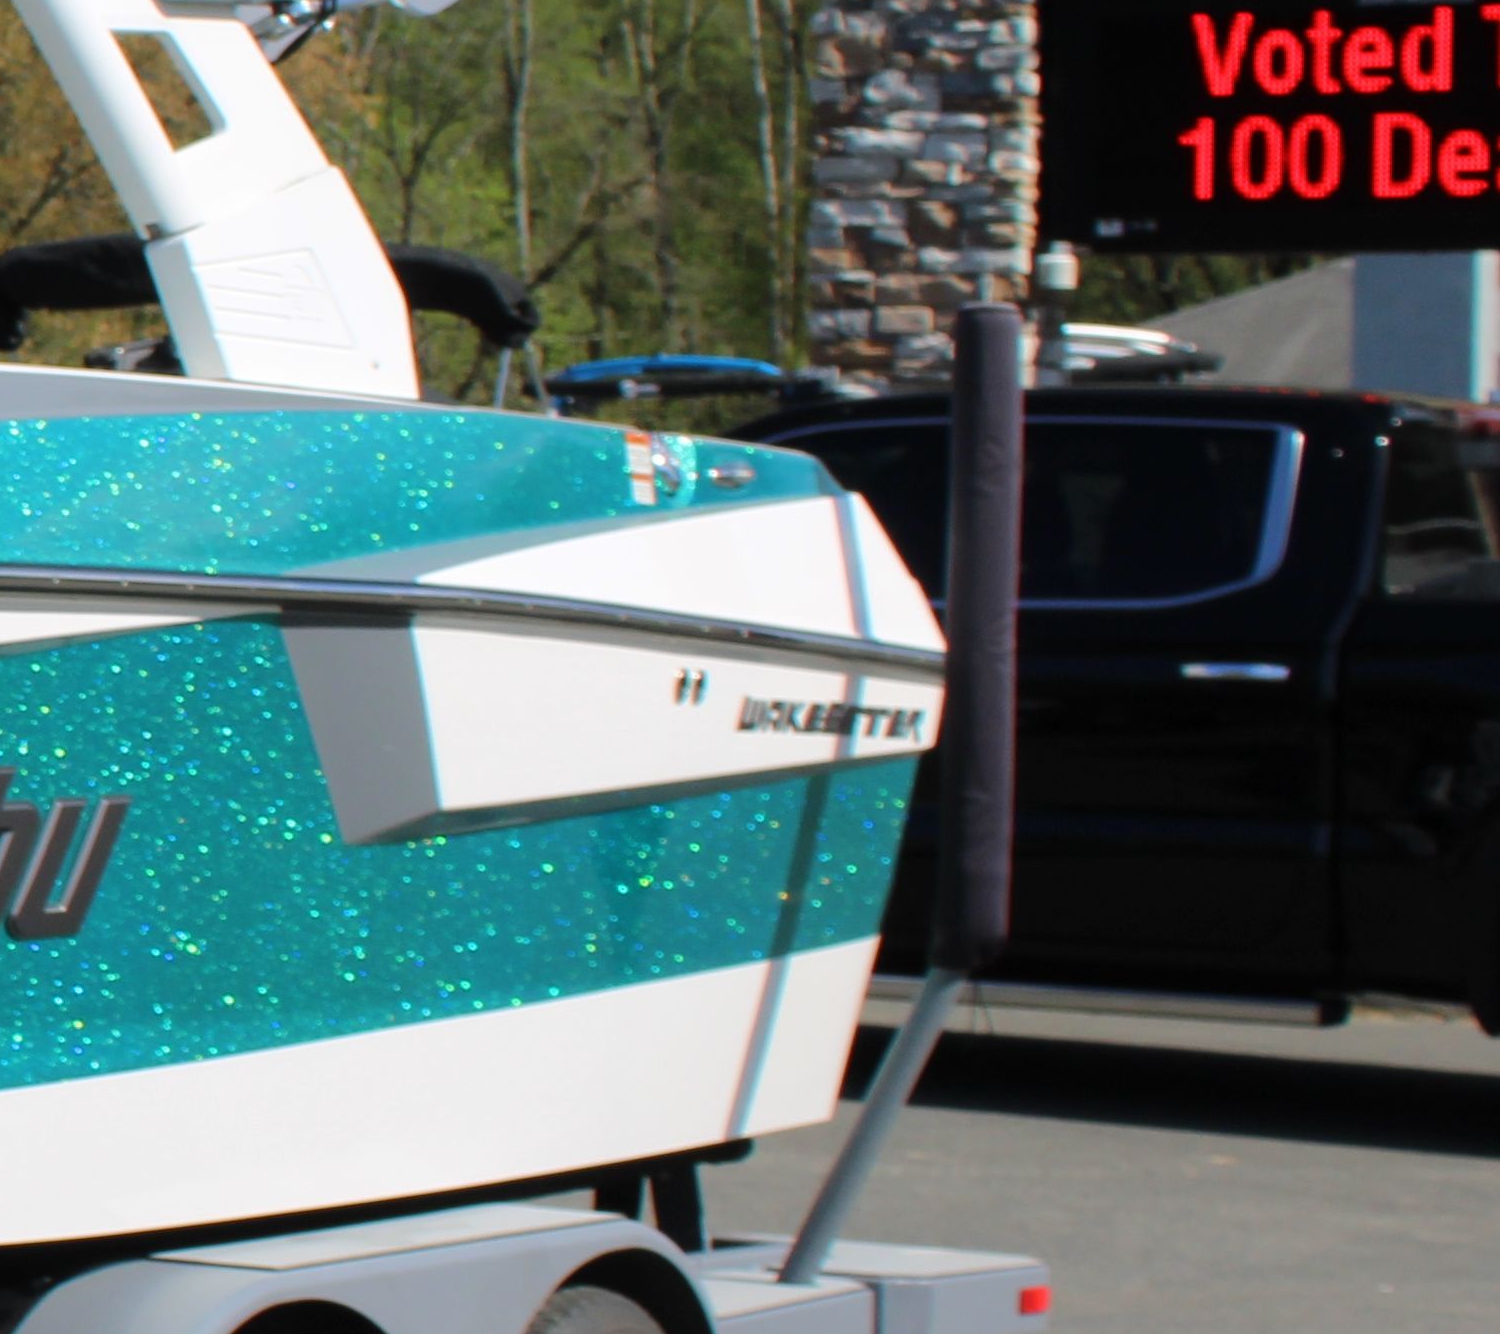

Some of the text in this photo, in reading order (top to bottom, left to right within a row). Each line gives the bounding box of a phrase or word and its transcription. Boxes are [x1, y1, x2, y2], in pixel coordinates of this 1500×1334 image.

[1190, 4, 1455, 97] Voted
[1176, 111, 1500, 201] 100 De
